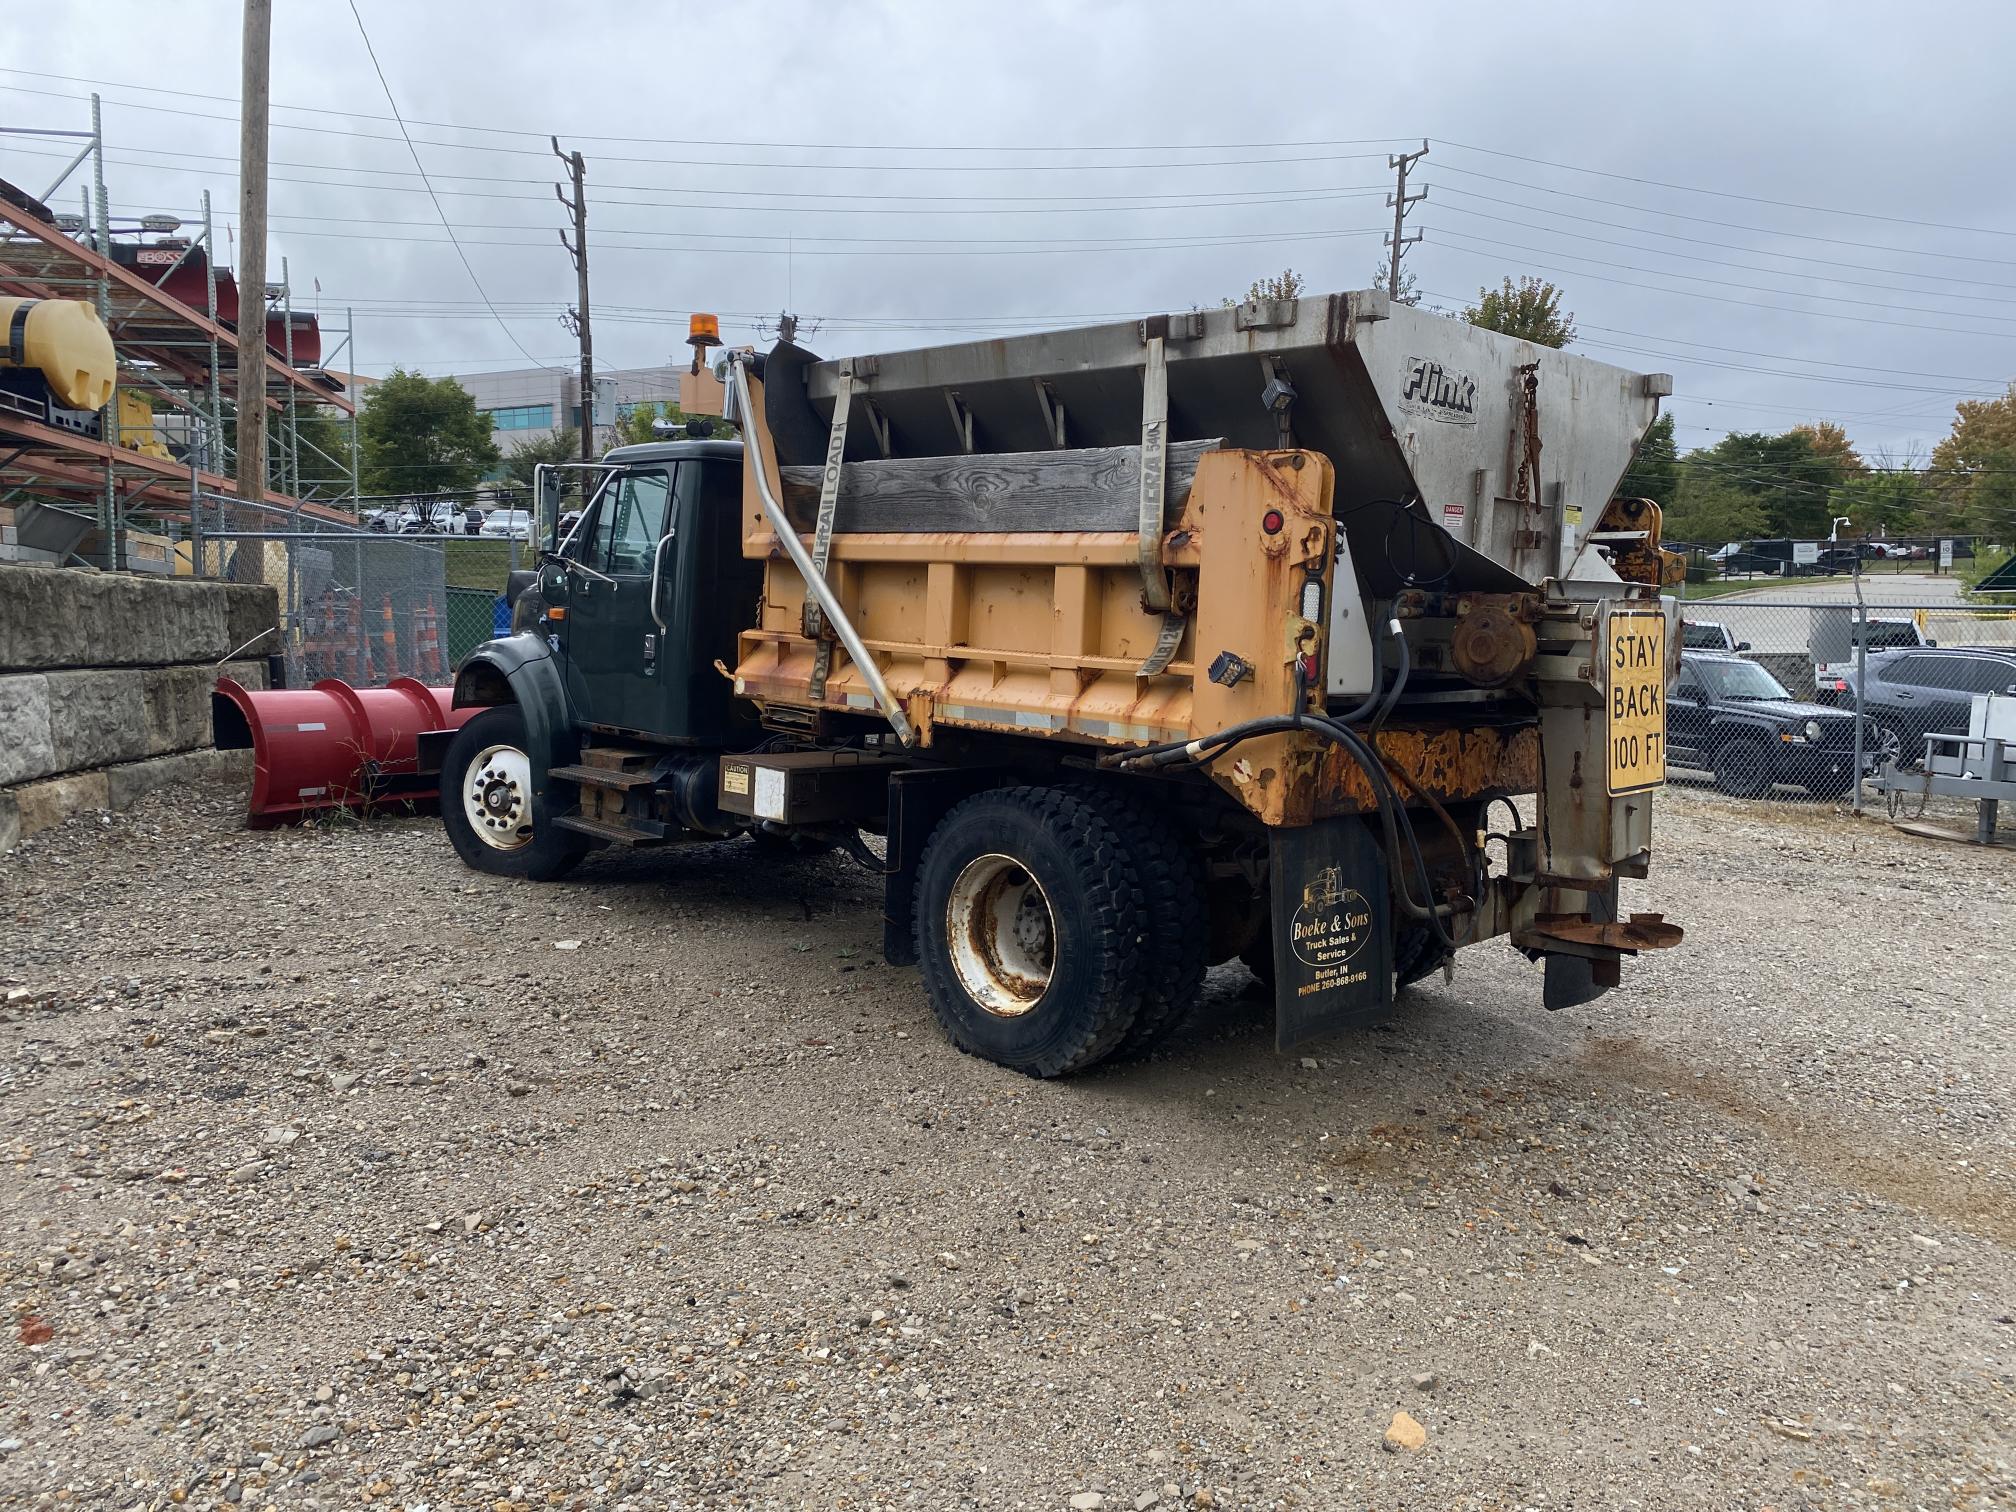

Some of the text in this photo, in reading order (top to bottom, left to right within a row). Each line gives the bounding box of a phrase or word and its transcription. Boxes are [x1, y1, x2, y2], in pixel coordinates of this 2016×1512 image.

[144, 251, 184, 263] BOSS
[1403, 357, 1475, 413] Flink
[824, 436, 843, 495] LOAD
[1615, 635, 1659, 668] STAY
[1614, 684, 1660, 719] BACK
[1613, 732, 1661, 770] 100 FT
[726, 764, 748, 774] CAUTION
[1293, 912, 1368, 940] Boeke & Sons
[1306, 932, 1357, 950] Truck Sales &
[1317, 949, 1346, 961] Service
[1315, 965, 1348, 980] Butler, IN
[1298, 982, 1321, 997] PHONE
